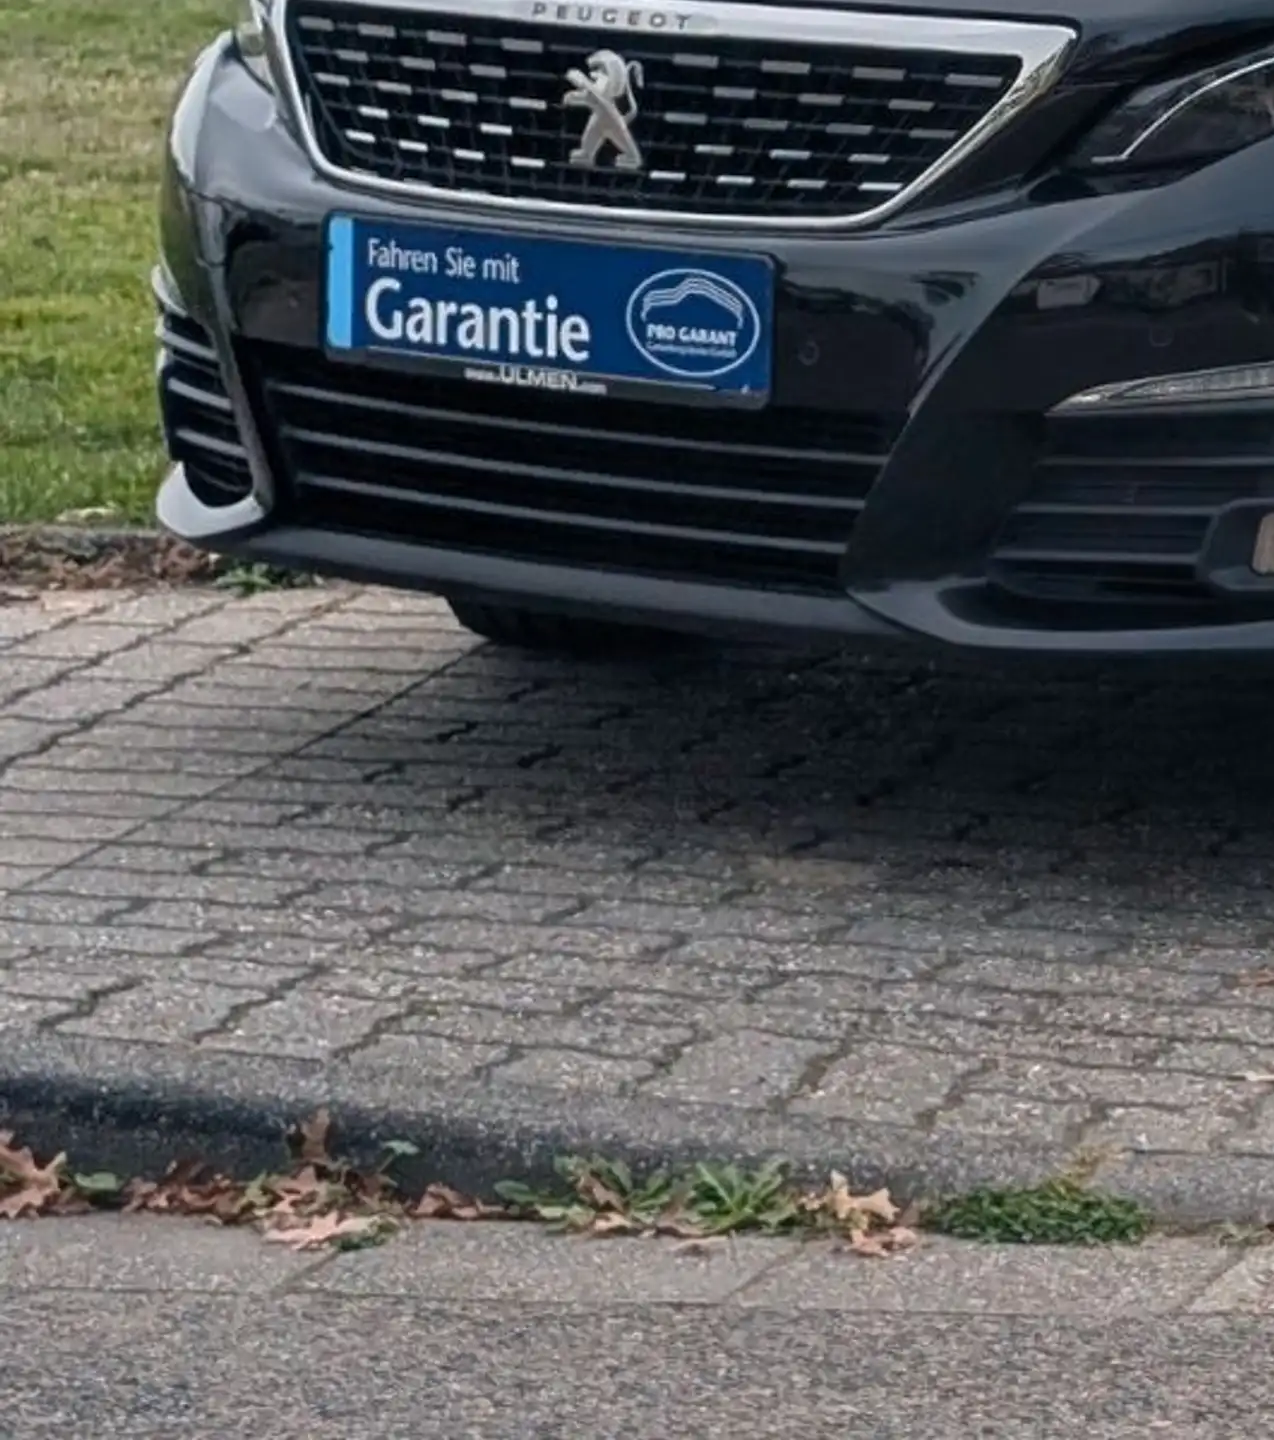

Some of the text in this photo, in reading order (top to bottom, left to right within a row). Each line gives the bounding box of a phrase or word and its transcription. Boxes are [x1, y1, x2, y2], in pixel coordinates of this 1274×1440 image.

[531, 1, 692, 30] PEUGEOT
[367, 238, 521, 284] Fahren Sie mit
[365, 276, 591, 362] Garantie
